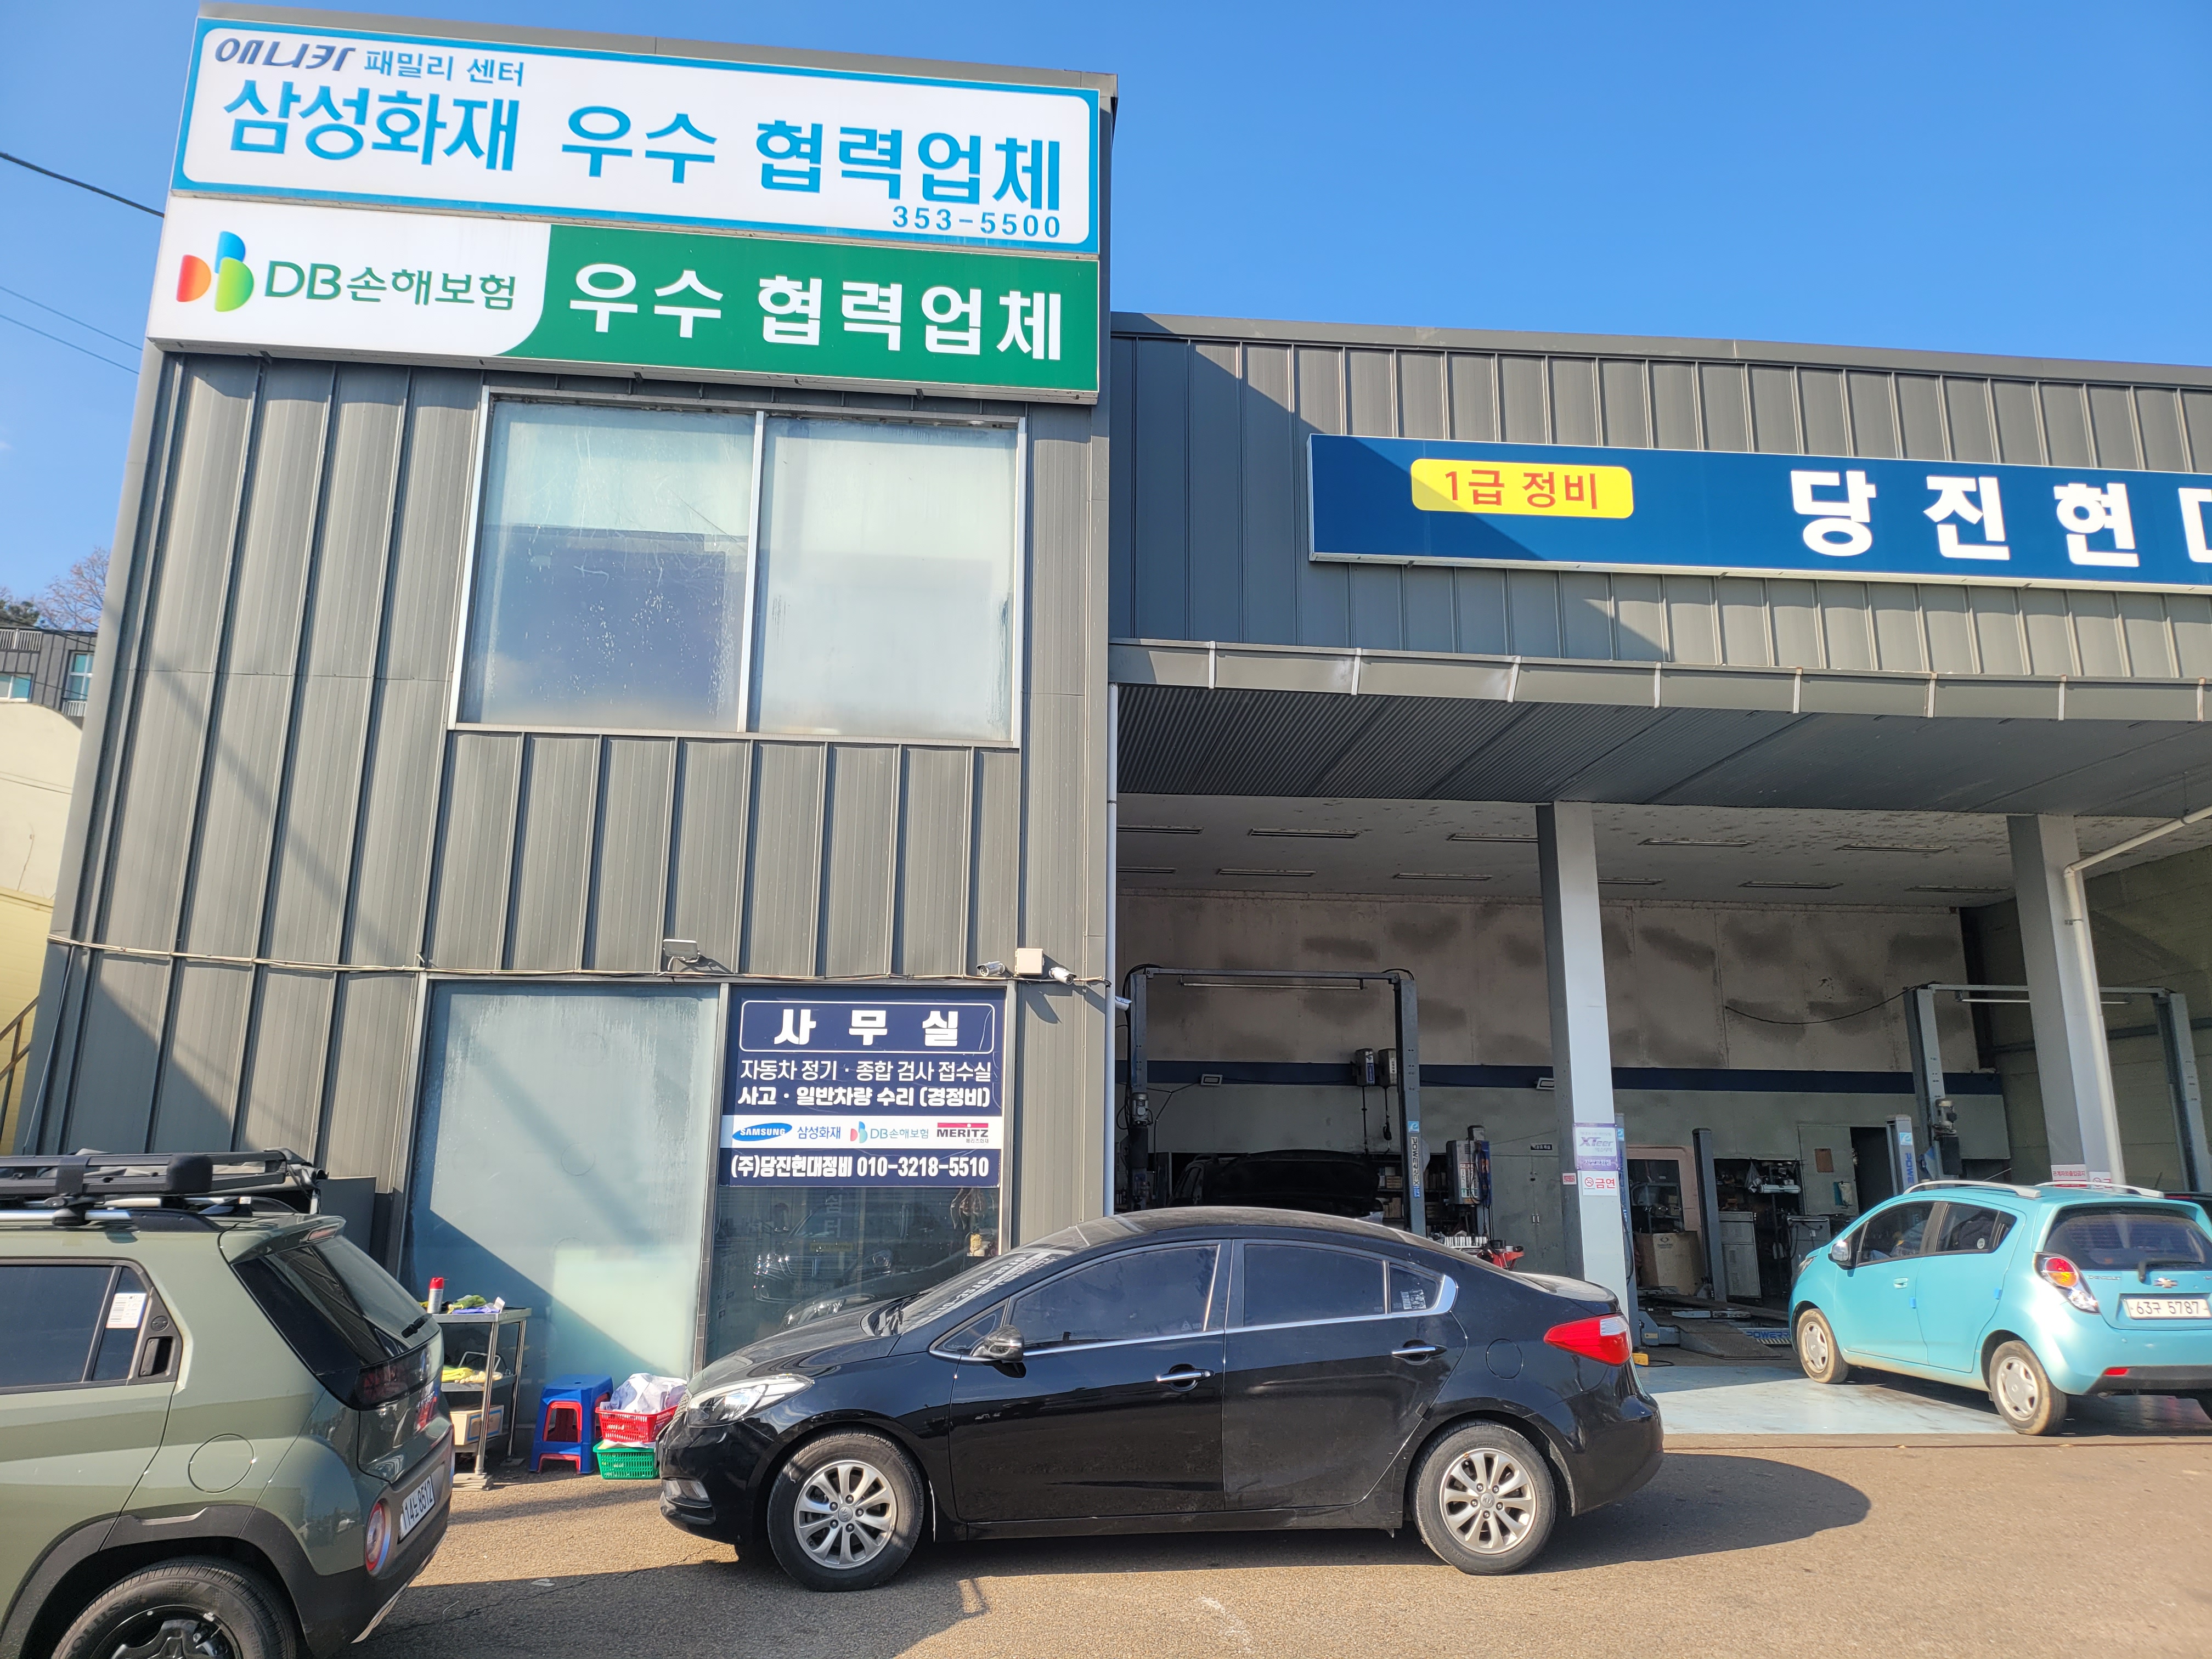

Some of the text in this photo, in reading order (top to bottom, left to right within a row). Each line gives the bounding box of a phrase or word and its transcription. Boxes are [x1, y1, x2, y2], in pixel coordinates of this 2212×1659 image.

[215, 37, 524, 86] 애니카 패밀리 센터
[223, 79, 1060, 211] 삼성화재 우수 협력업체
[892, 205, 1060, 238] 353-5500
[264, 259, 1062, 360] DB손해보험 우수 협력업체
[1444, 469, 1598, 510] 1급 정비
[740, 1059, 991, 1082] 자동차 정기 종합 검사 접수실
[737, 1086, 990, 1107] 사고 일반차량 수리 (경정비)
[740, 1127, 786, 1136] SAMSUNG
[797, 1126, 841, 1139] 삼성화재
[870, 1128, 929, 1139] DB손해보험
[936, 1129, 989, 1138] MERITZ
[1579, 1137, 1614, 1147] XTeer
[731, 1155, 989, 1177] (주)당진현대정비 010-3218-5510
[1595, 1178, 1616, 1189] 금연
[2136, 1301, 2199, 1314] 63구 5787
[417, 1480, 433, 1513] 8512
[1482, 1497, 1494, 1505] KIA
